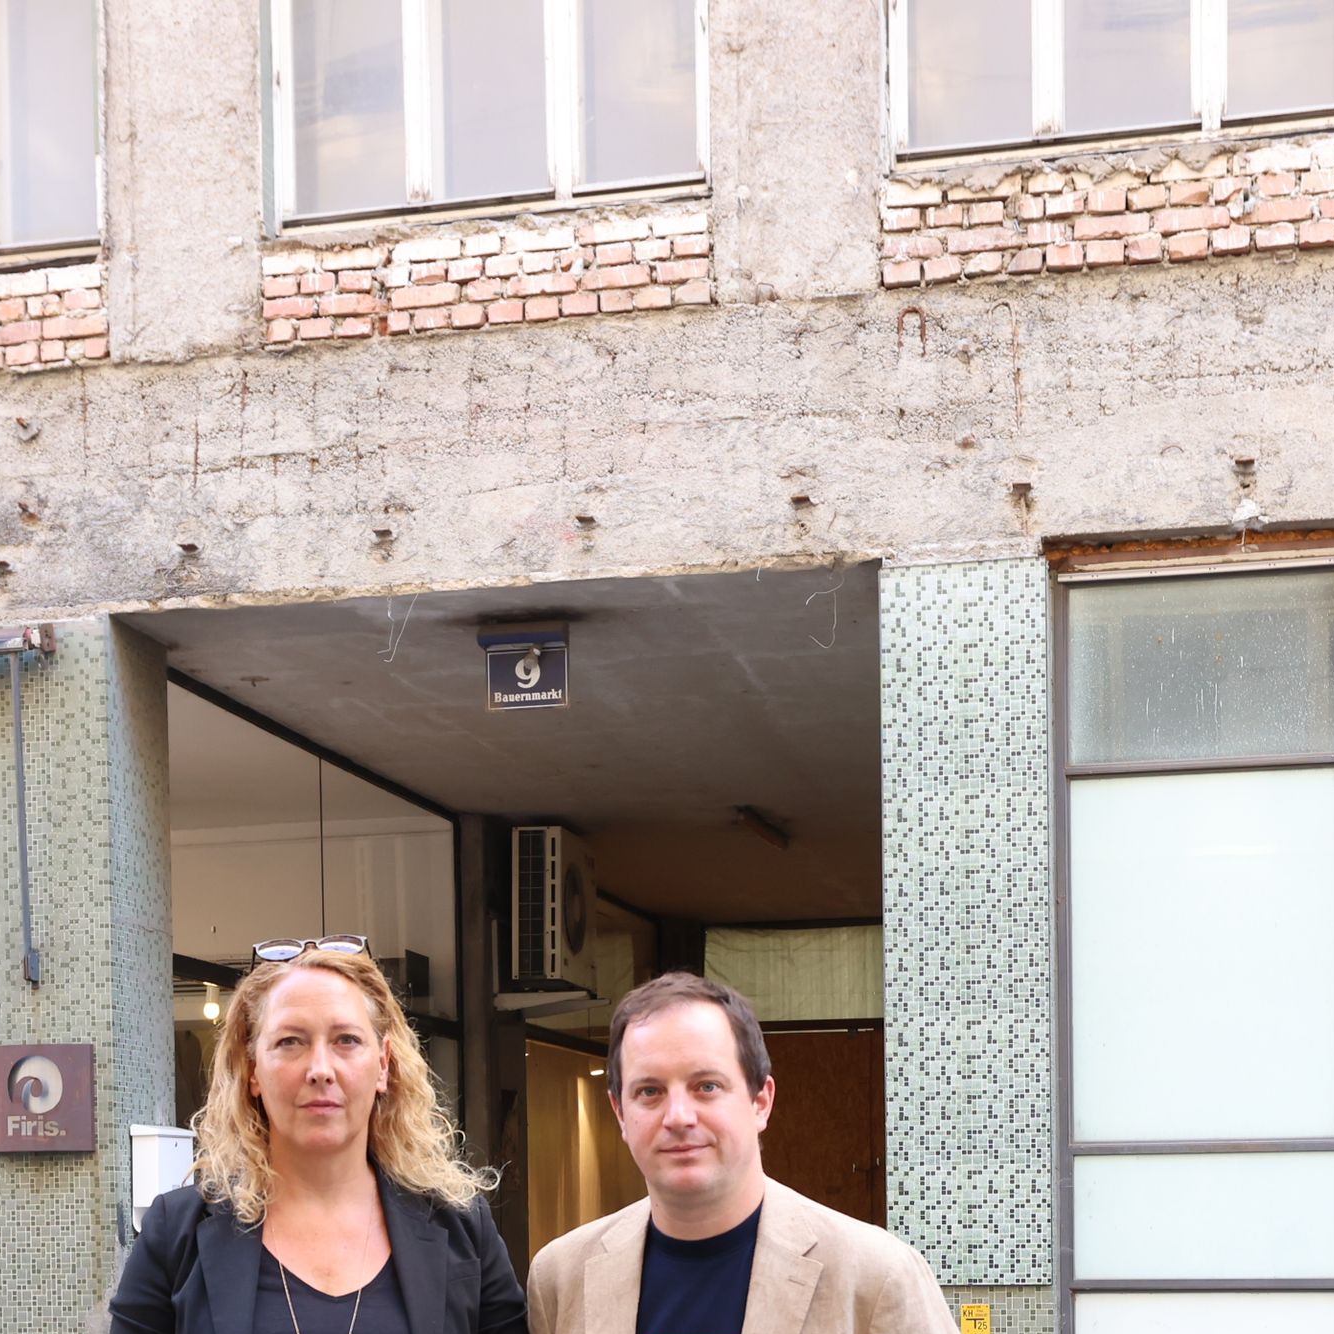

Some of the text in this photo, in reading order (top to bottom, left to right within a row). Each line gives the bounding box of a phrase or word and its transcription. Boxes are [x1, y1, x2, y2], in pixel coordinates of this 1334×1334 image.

[515, 657, 541, 689] 9
[494, 688, 562, 703] Bauernmarkt
[7, 1115, 66, 1136] Firis.
